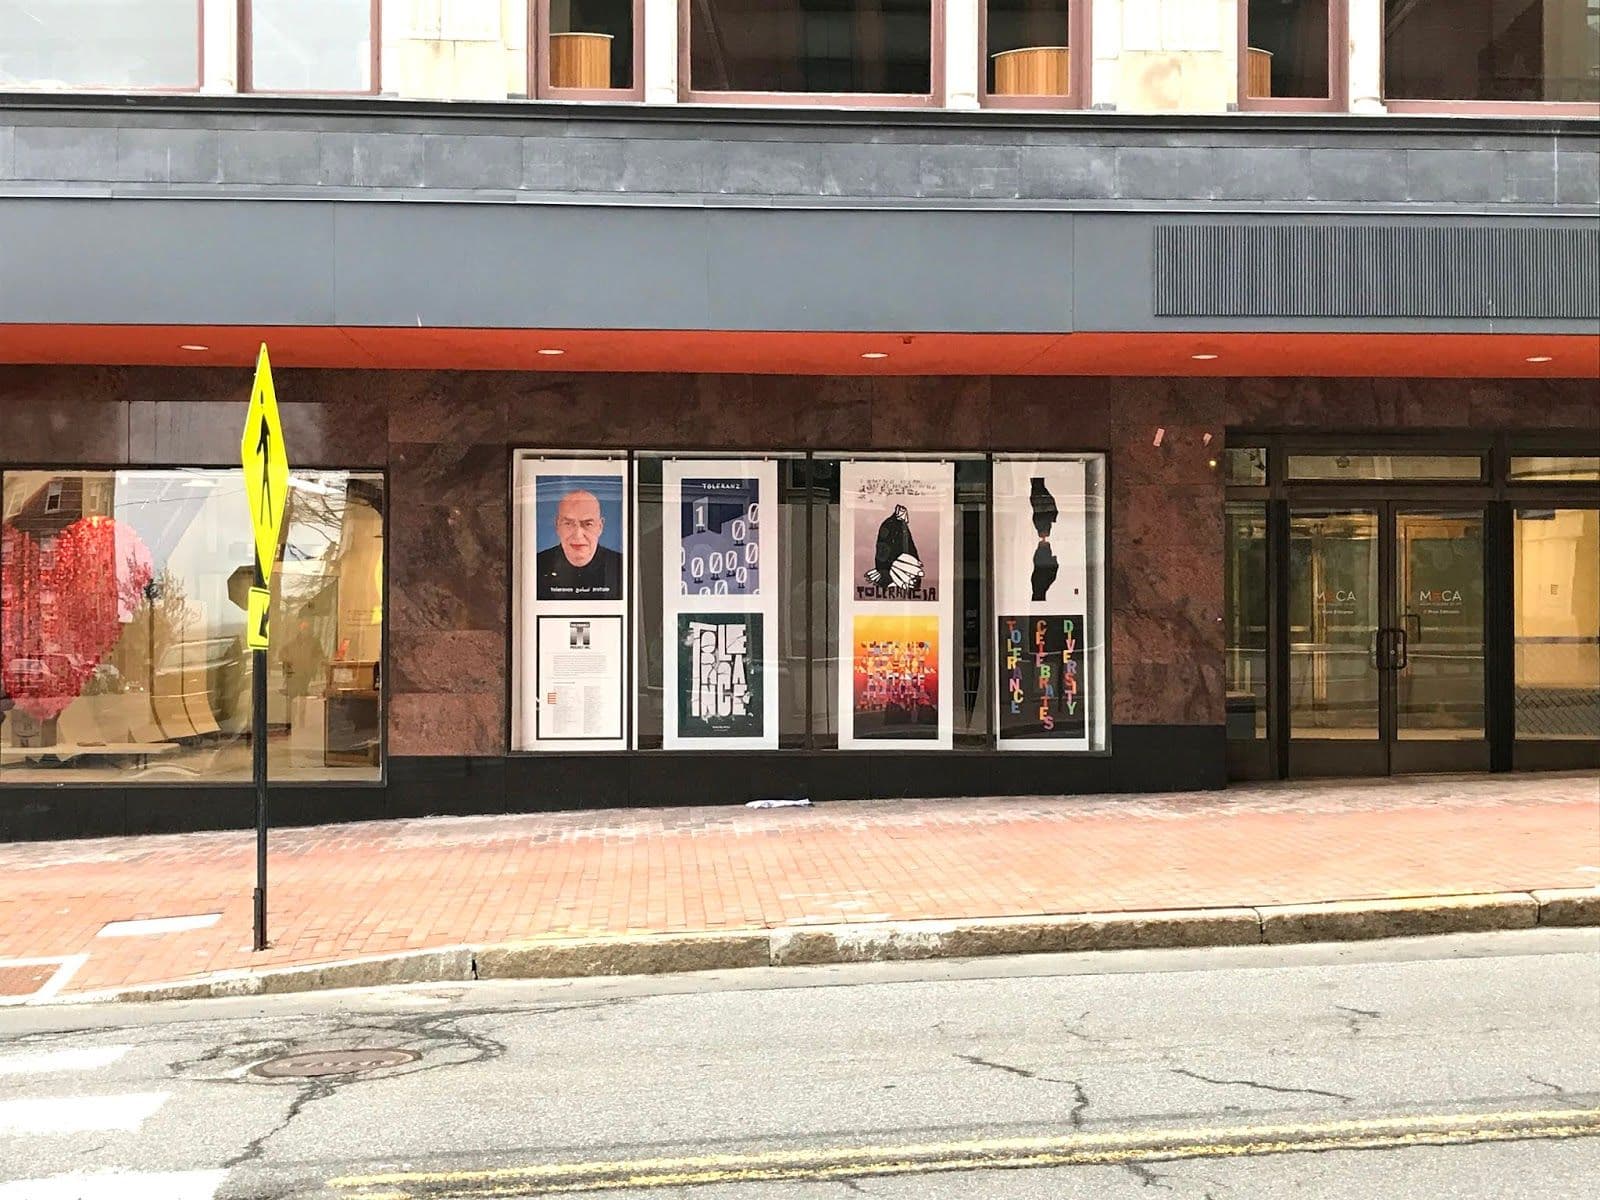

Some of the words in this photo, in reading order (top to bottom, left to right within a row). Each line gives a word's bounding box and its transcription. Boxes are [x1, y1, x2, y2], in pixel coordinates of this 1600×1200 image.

[702, 482, 740, 490] TOLERANZ
[1006, 619, 1024, 714] TOLERANCE
[1062, 619, 1078, 715] DIVERSITY
